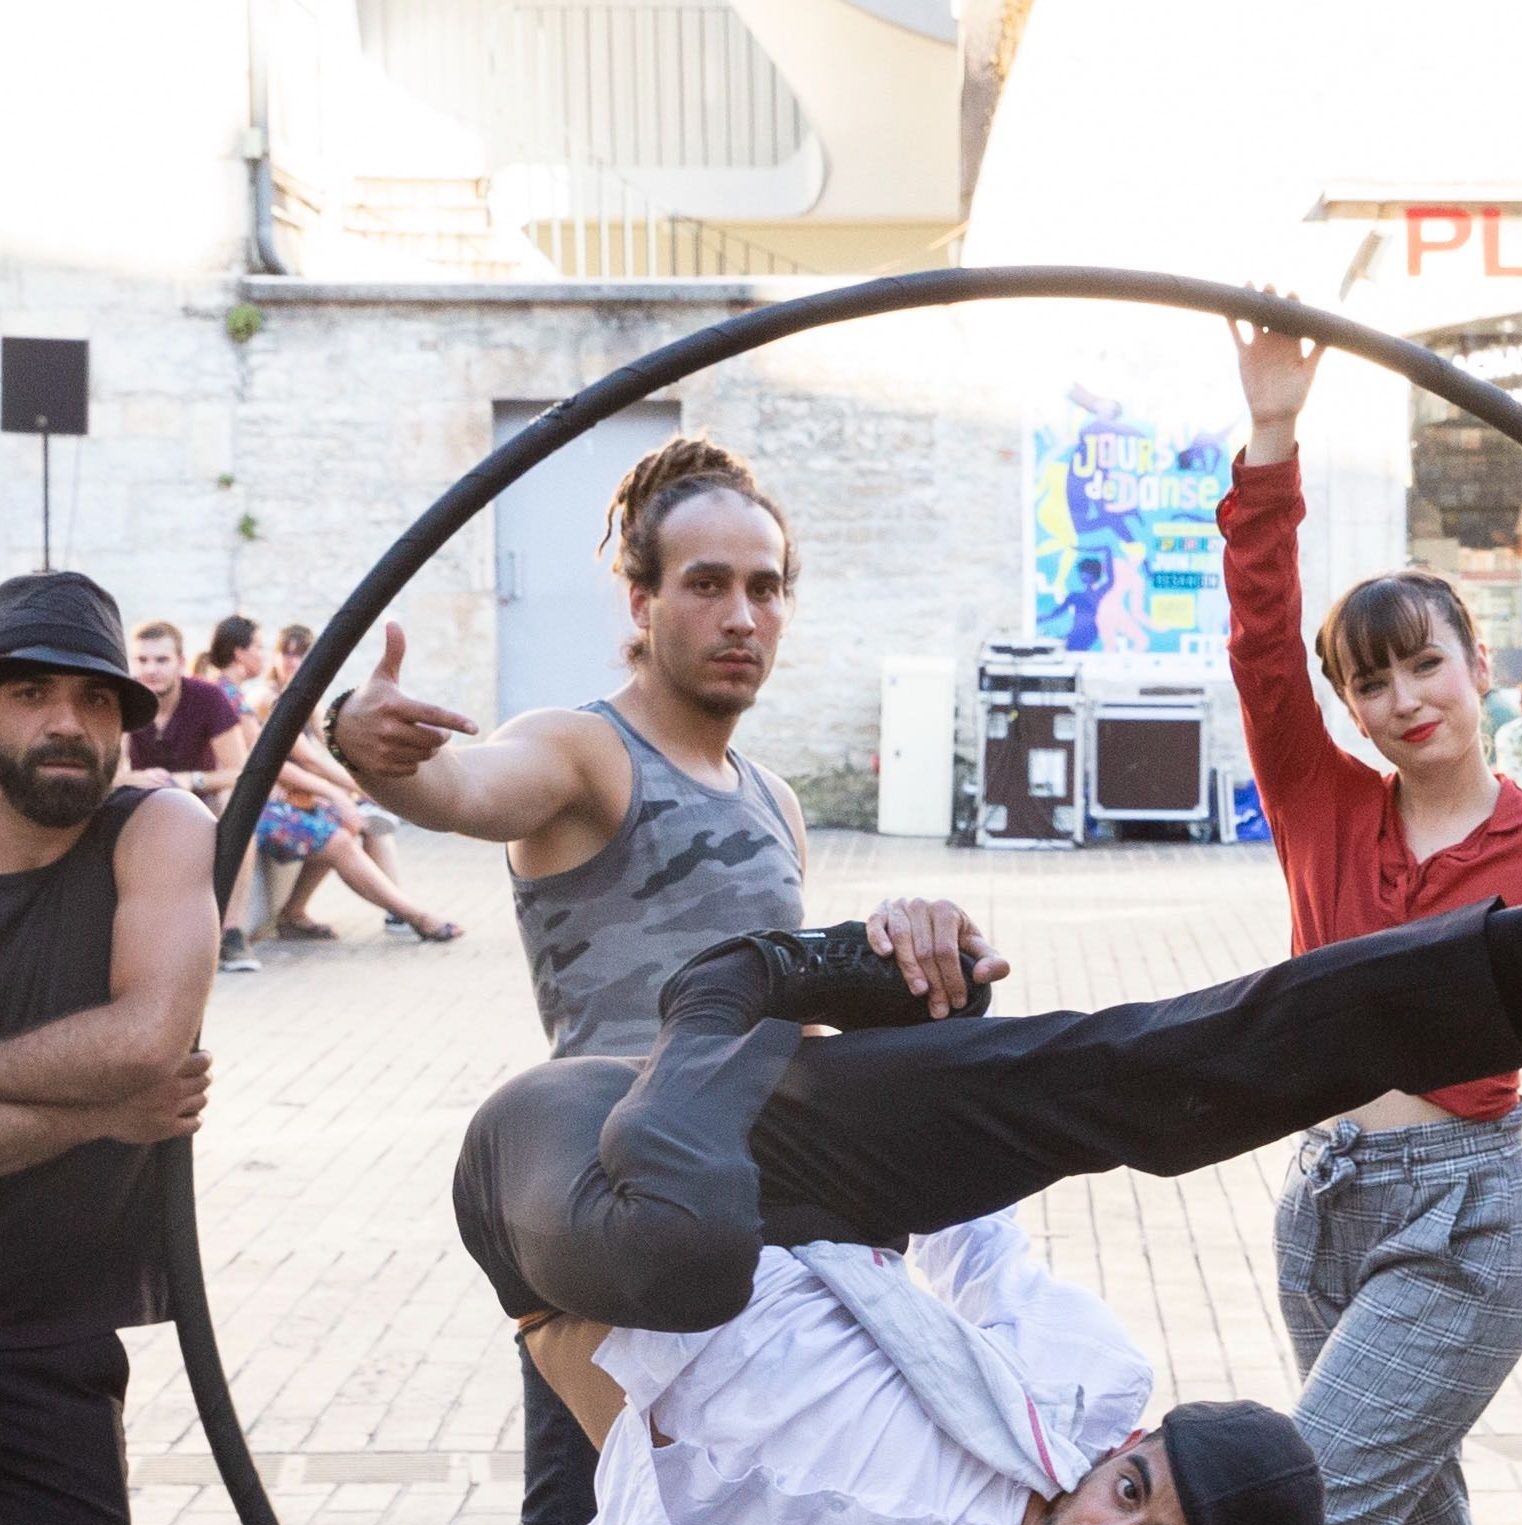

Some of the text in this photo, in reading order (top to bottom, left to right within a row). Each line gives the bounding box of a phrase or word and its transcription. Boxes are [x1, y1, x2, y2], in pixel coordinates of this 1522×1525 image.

[1073, 433, 1175, 477] JOURS
[1084, 470, 1219, 512] de Danse
